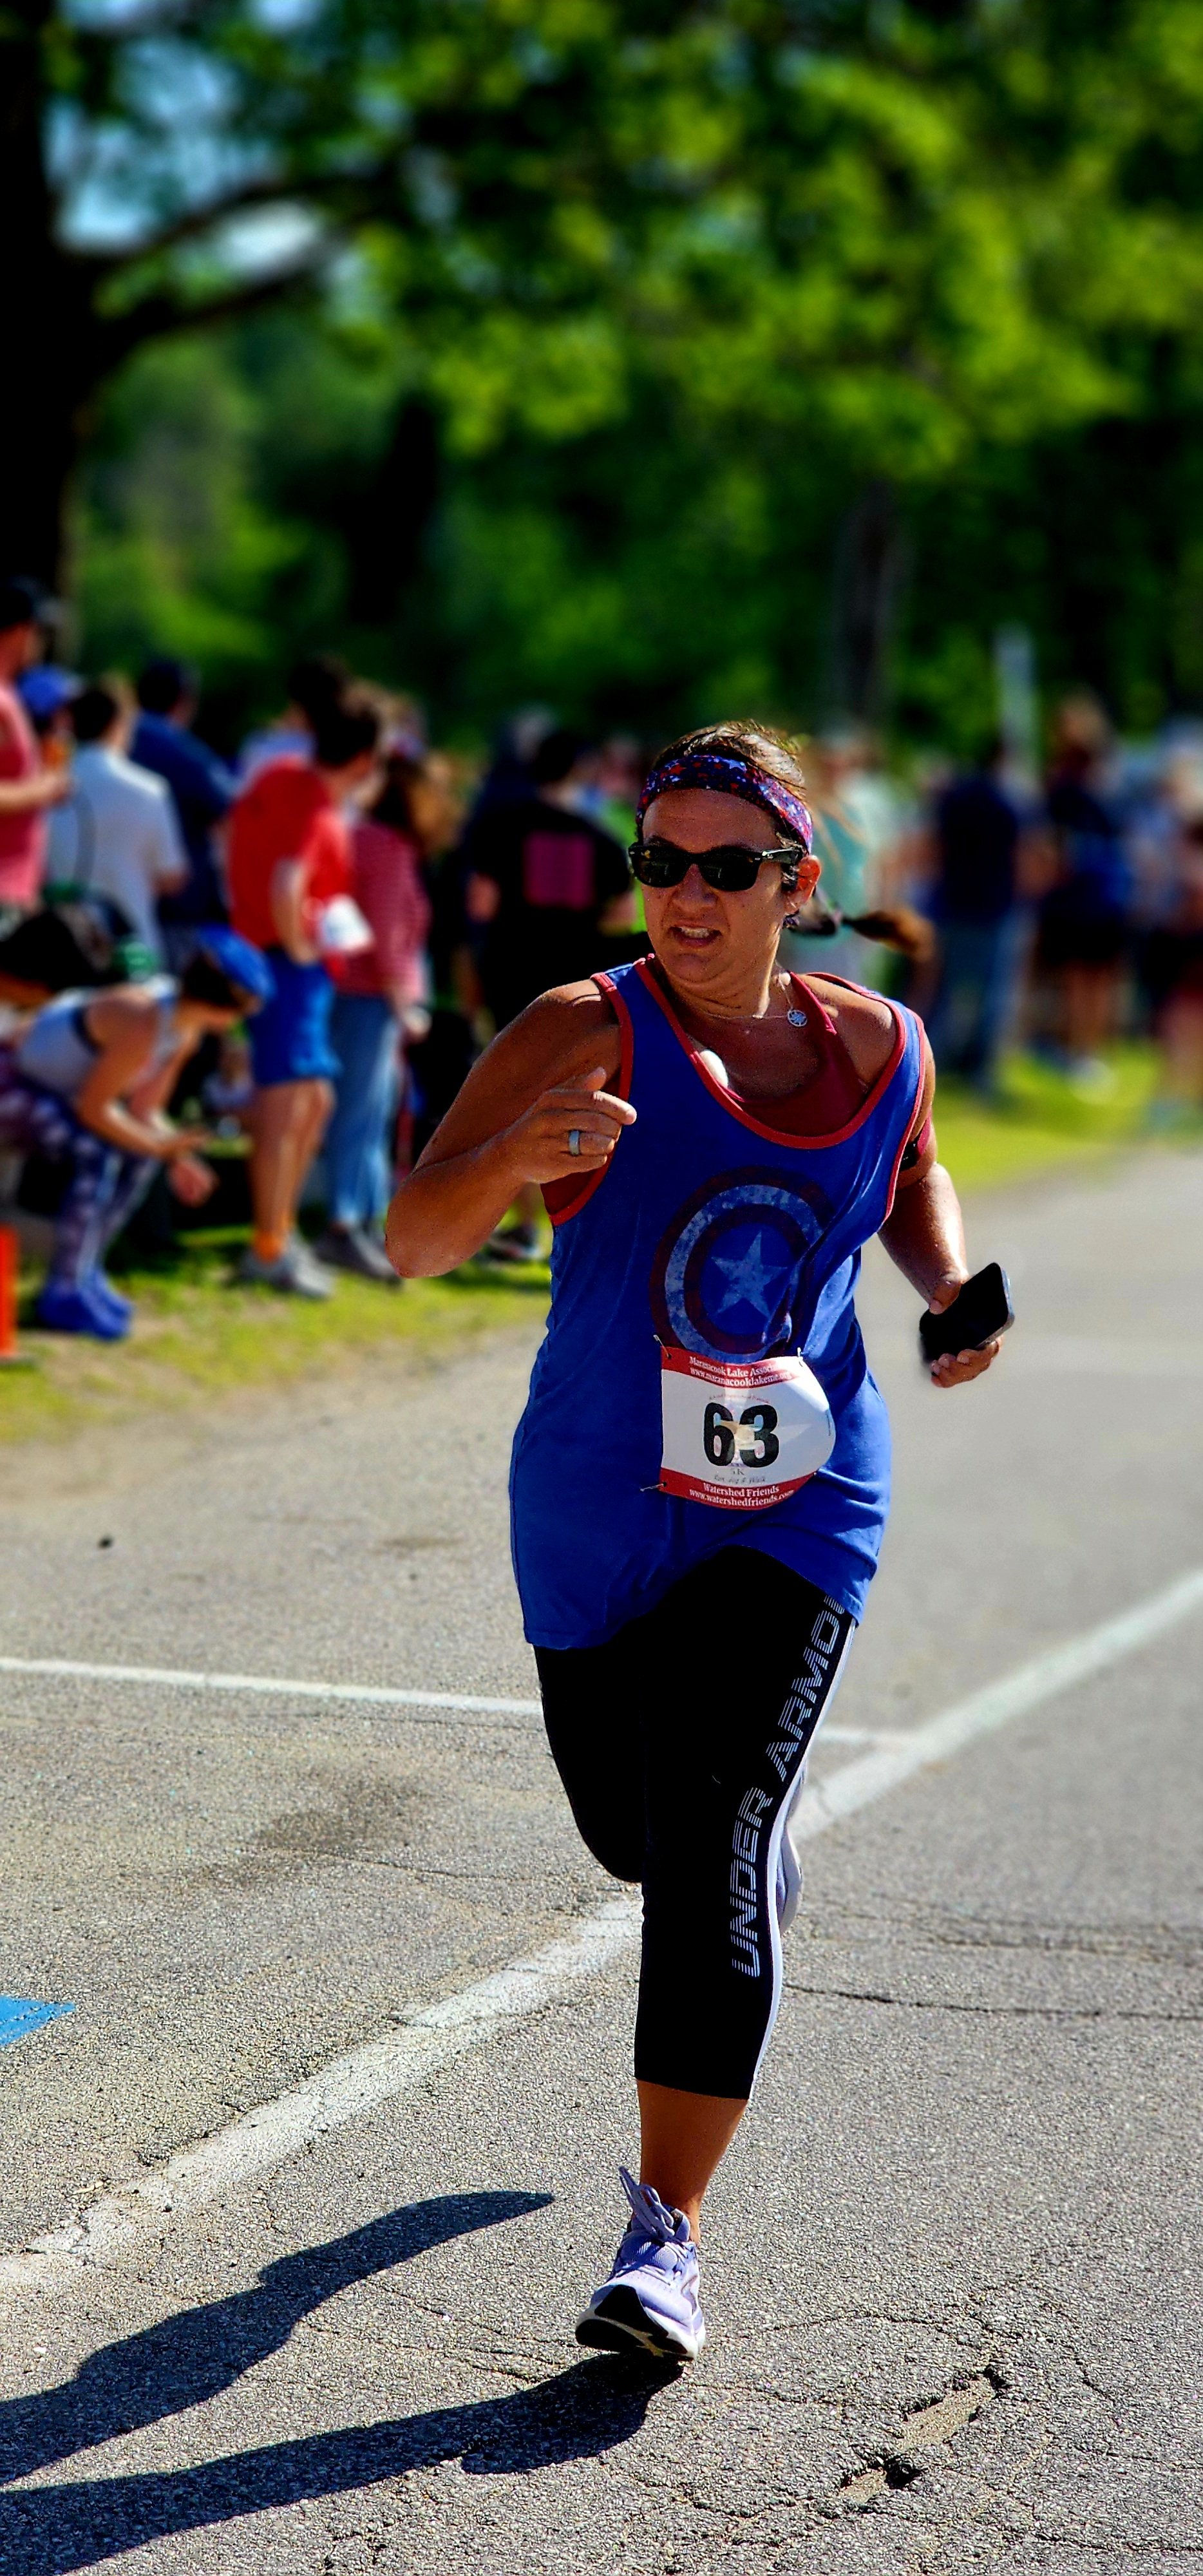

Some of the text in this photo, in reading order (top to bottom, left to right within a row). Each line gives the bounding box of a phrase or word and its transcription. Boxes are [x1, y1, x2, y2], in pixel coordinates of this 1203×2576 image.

[726, 1367, 748, 1377] Lake
[704, 1402, 779, 1468] 63
[703, 1482, 779, 1497] Watershed Friends
[730, 1595, 845, 1978] UNDER ARMO
